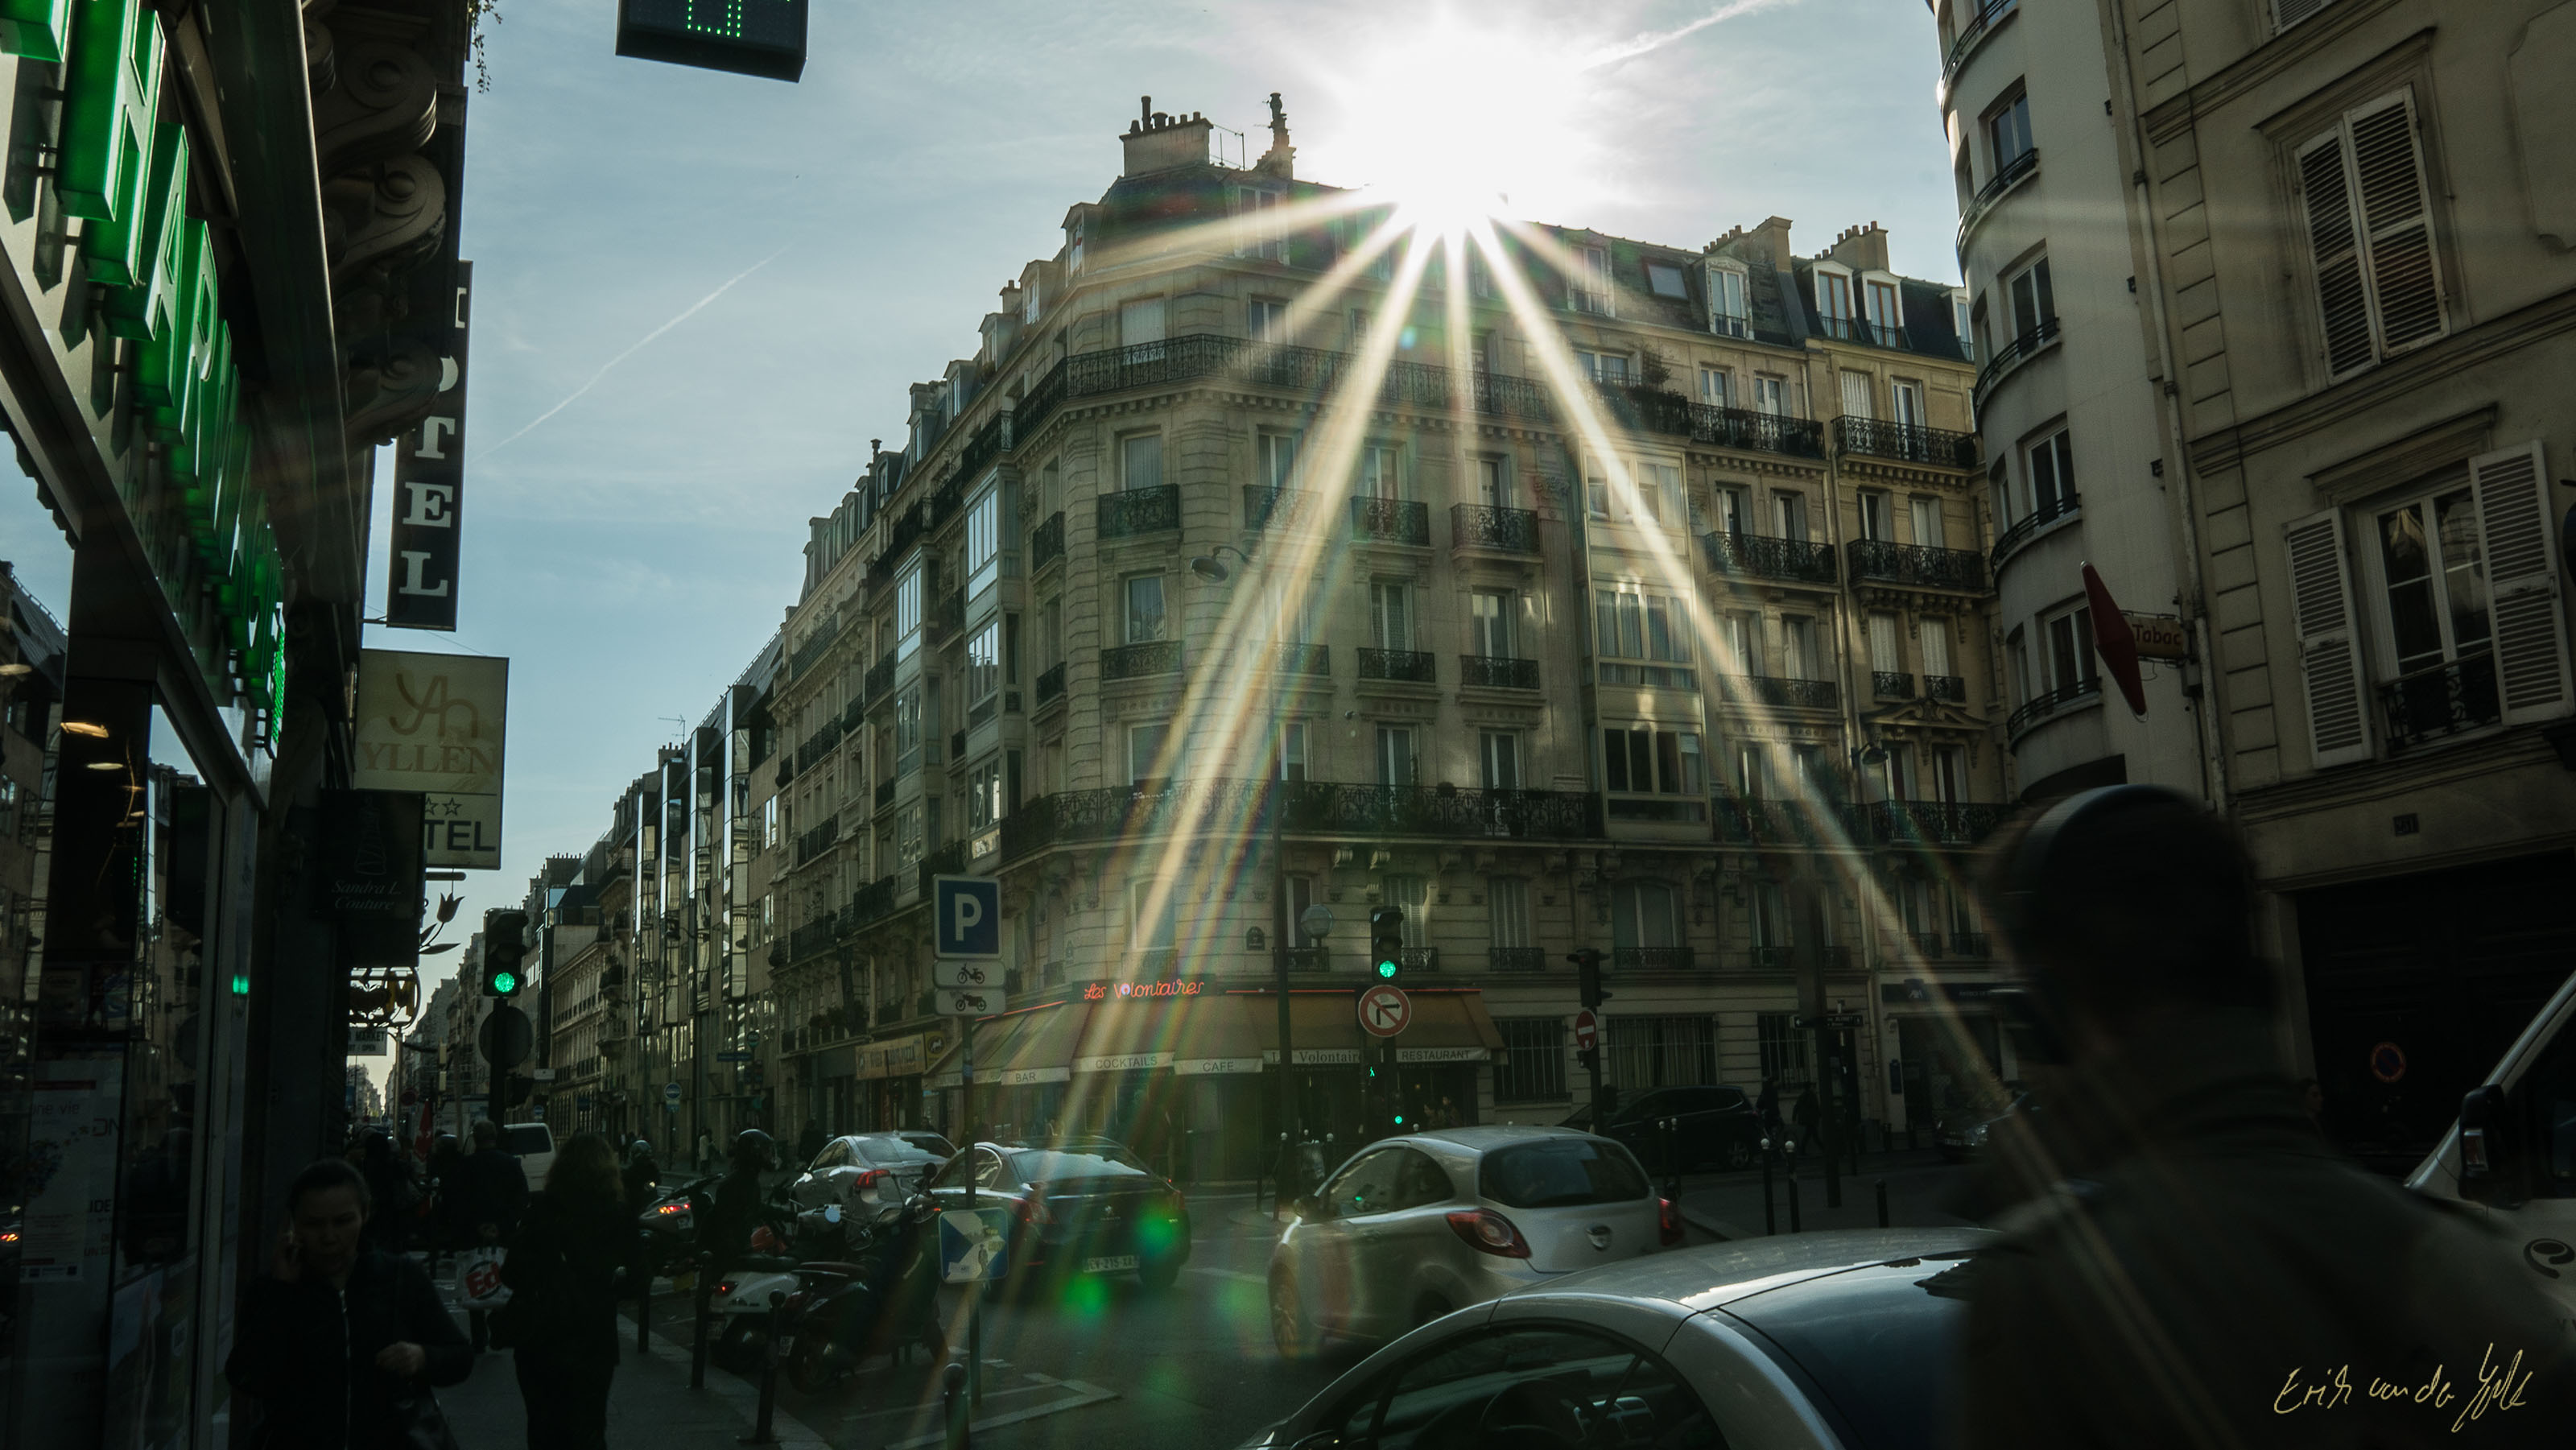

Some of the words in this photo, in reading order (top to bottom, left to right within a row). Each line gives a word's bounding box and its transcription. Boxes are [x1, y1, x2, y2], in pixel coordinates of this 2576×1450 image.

[2132, 624, 2180, 645] Tabac
[359, 741, 498, 776] YLLEN
[424, 820, 497, 852] TEL
[331, 879, 386, 895] Sandra
[334, 897, 395, 911] Couture
[954, 892, 983, 941] P
[1084, 983, 1107, 1000] Les
[1113, 978, 1205, 1000] Volontaires
[1095, 1055, 1158, 1069] COCKTAILS
[1298, 1050, 1360, 1064] Volontair
[1402, 1049, 1470, 1061] RESTAURANT
[1203, 1061, 1234, 1072] CAFE
[1015, 1072, 1037, 1083] BAR
